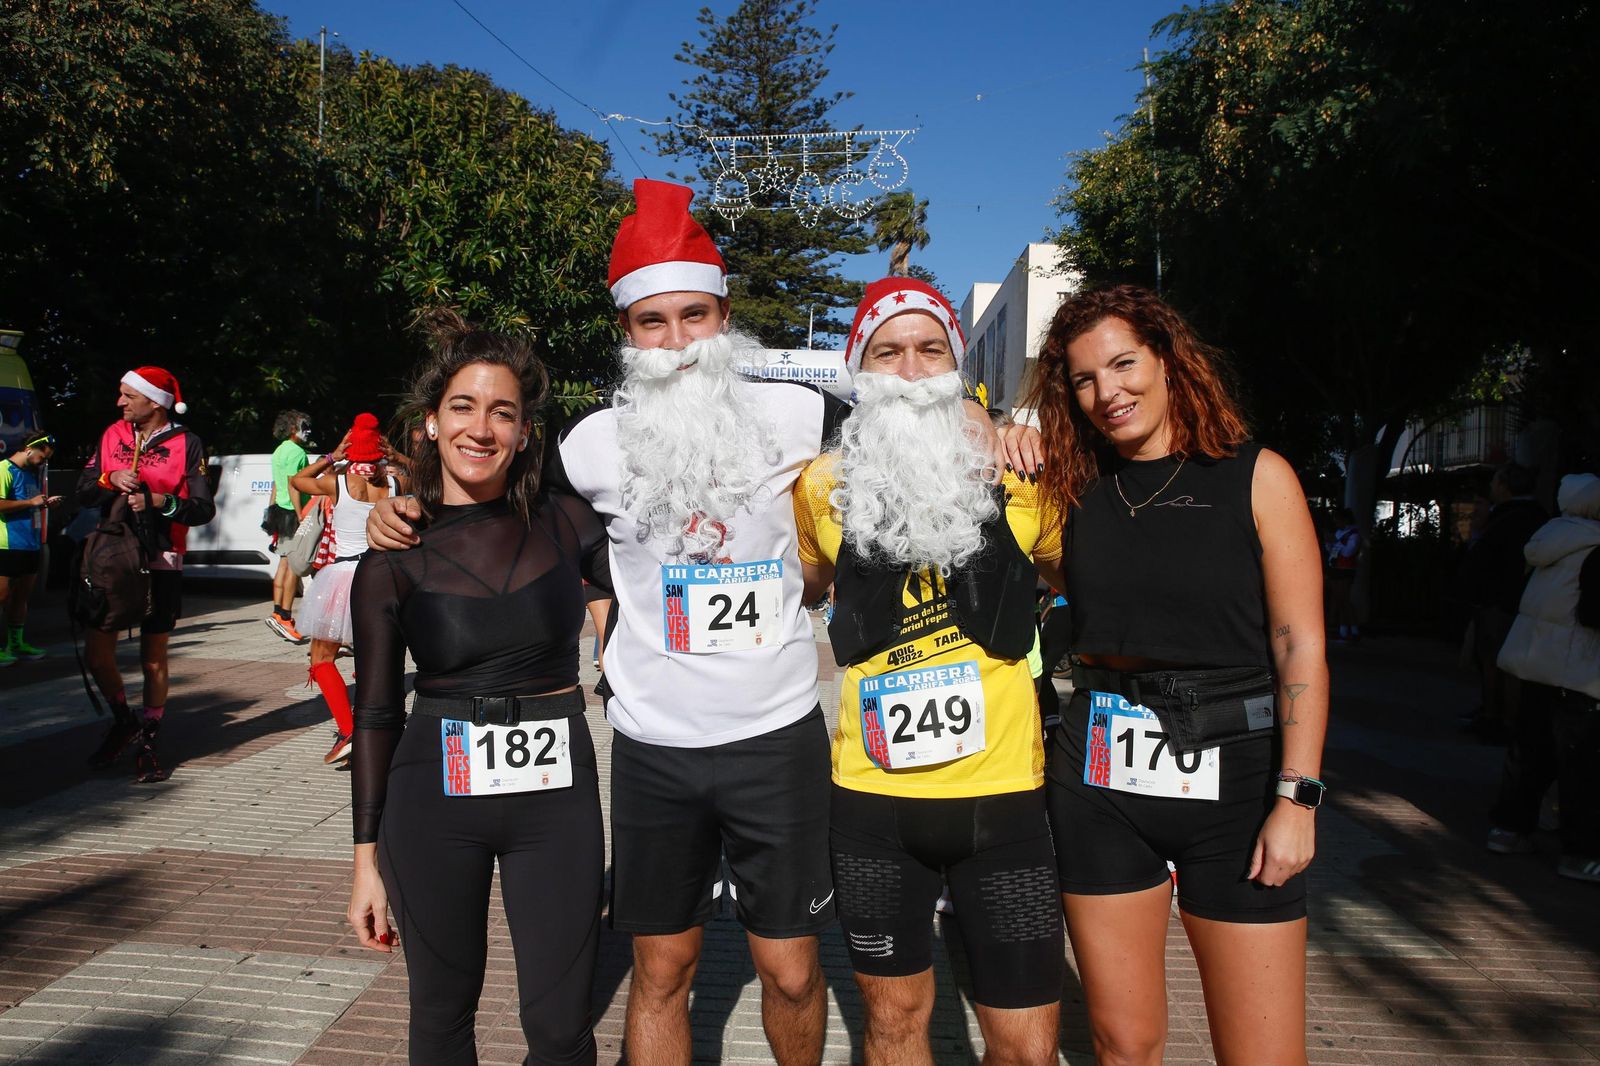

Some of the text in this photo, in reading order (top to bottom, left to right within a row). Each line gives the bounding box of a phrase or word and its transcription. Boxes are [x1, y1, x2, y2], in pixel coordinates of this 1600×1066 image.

[668, 563, 779, 579] III CARRERA
[719, 575, 753, 585] TARIFA
[666, 584, 683, 597] SAN
[667, 598, 684, 615] SIL
[708, 591, 760, 631] 24
[921, 605, 935, 617] del
[668, 616, 689, 633] VES
[900, 620, 924, 636] orial
[669, 634, 690, 651] TRE
[899, 650, 924, 663] 2022
[884, 664, 976, 689] CARRERA
[907, 681, 945, 692] TARIFA
[862, 697, 878, 712] SAN
[864, 711, 880, 731] SIL
[888, 695, 972, 744] 249
[1092, 712, 1108, 729] SAN
[445, 722, 464, 737] SAN
[1090, 727, 1107, 746] SIL
[446, 736, 465, 756] SIL
[476, 727, 557, 769] 182
[866, 730, 888, 750] VES
[1090, 745, 1110, 766] VES
[447, 755, 471, 775] VES
[447, 774, 471, 794] TRE
[1089, 765, 1111, 787] TRE
